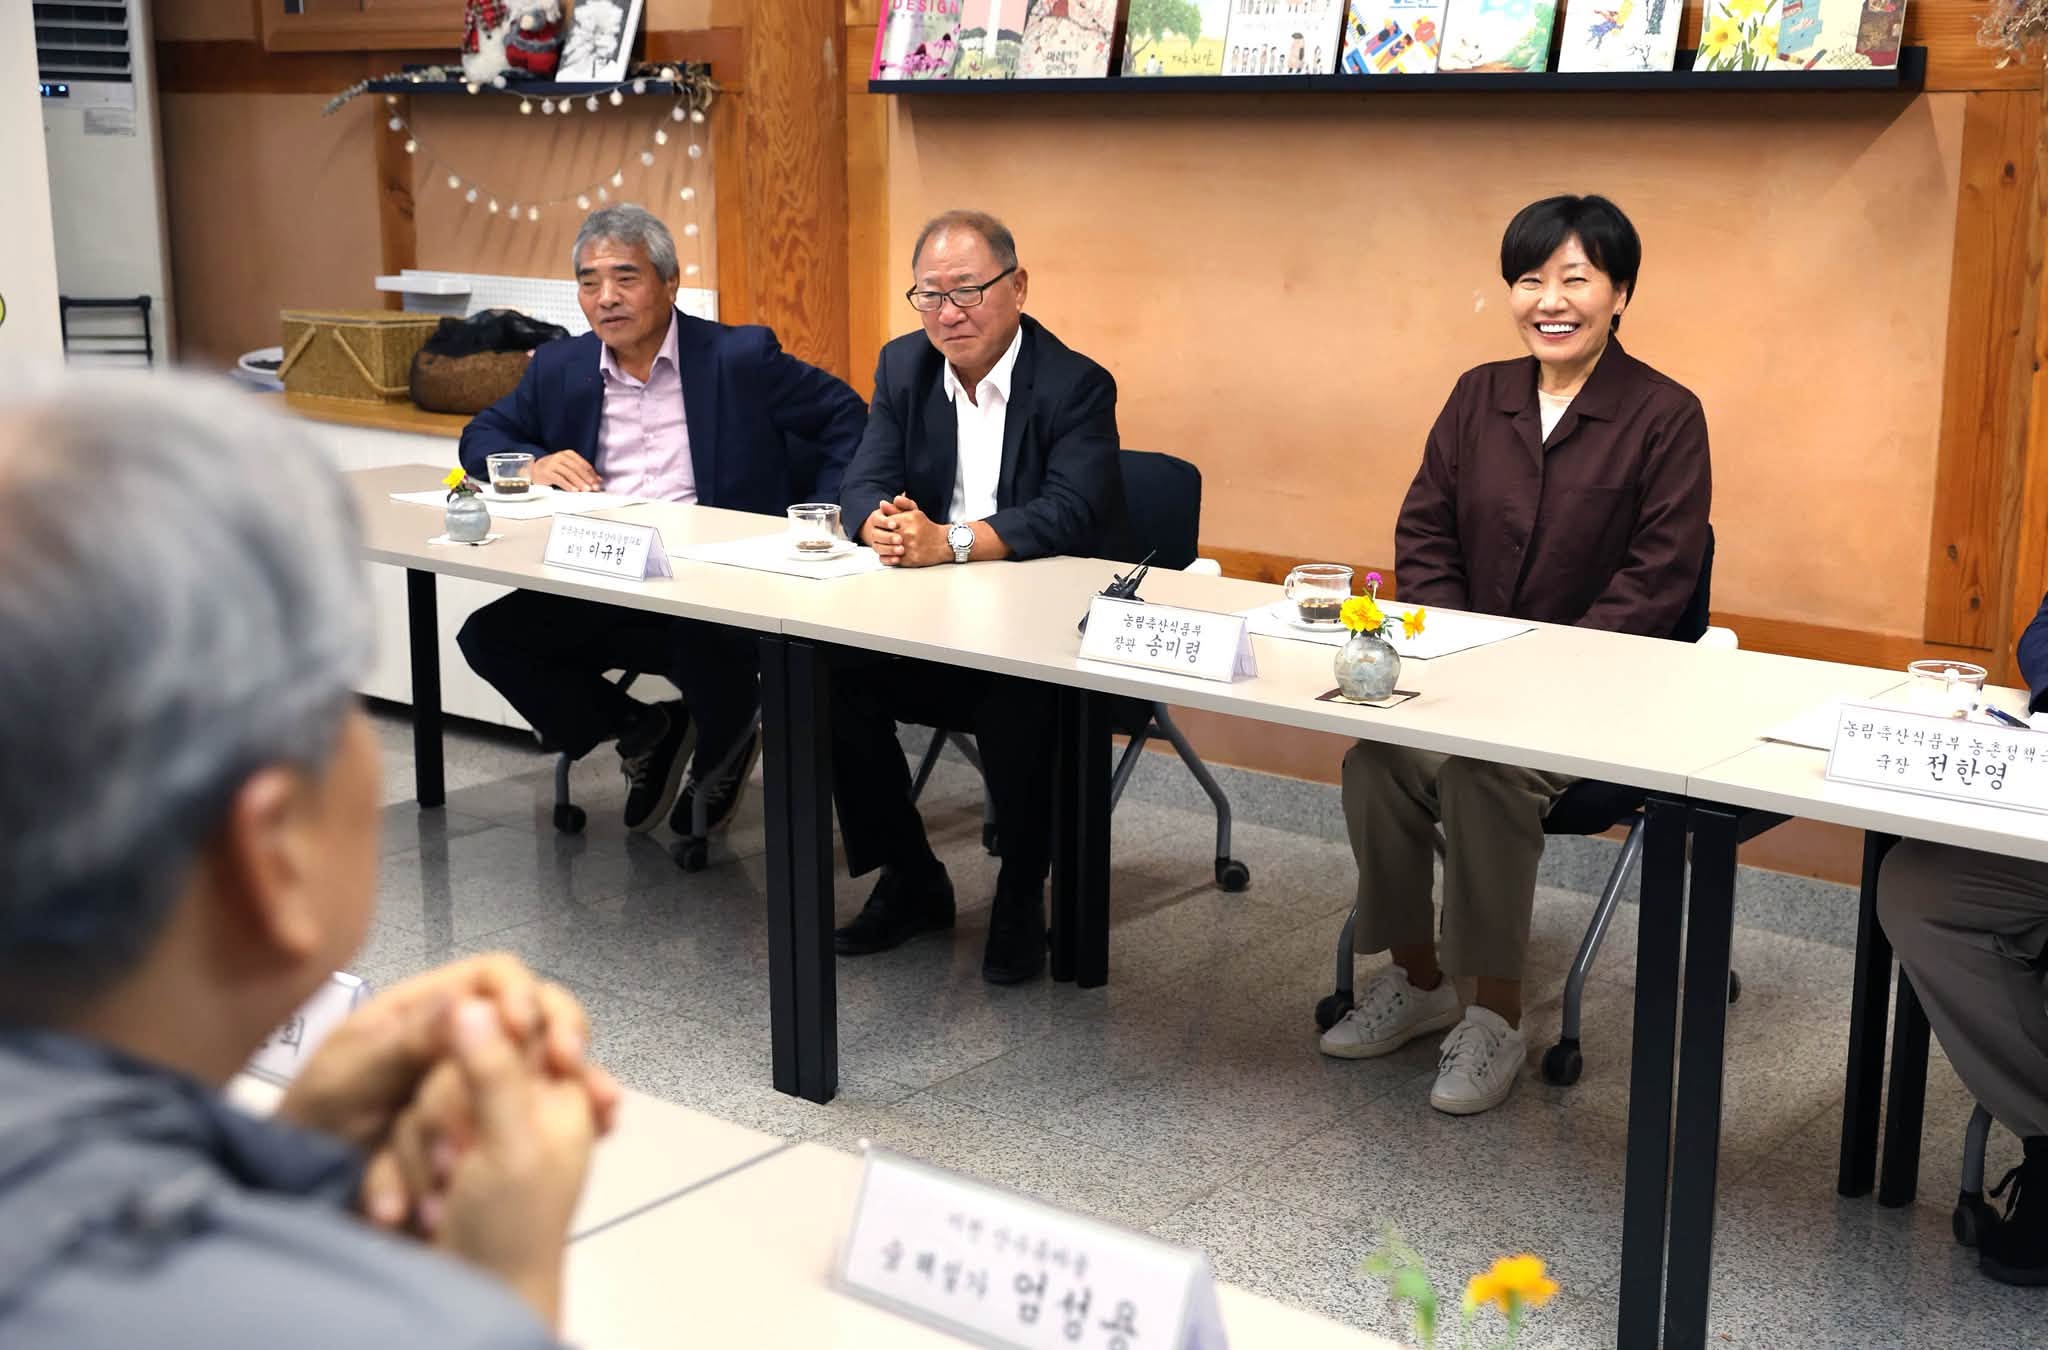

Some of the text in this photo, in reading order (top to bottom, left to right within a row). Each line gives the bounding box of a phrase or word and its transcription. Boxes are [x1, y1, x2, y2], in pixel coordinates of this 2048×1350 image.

[892, 0, 960, 13] DESIGN
[1123, 613, 1201, 637] 농림축산식품부
[1114, 634, 1201, 663] 장관 송미령
[1843, 720, 1960, 750] 농림축산식품부
[1875, 752, 2008, 790] 국장 전한영
